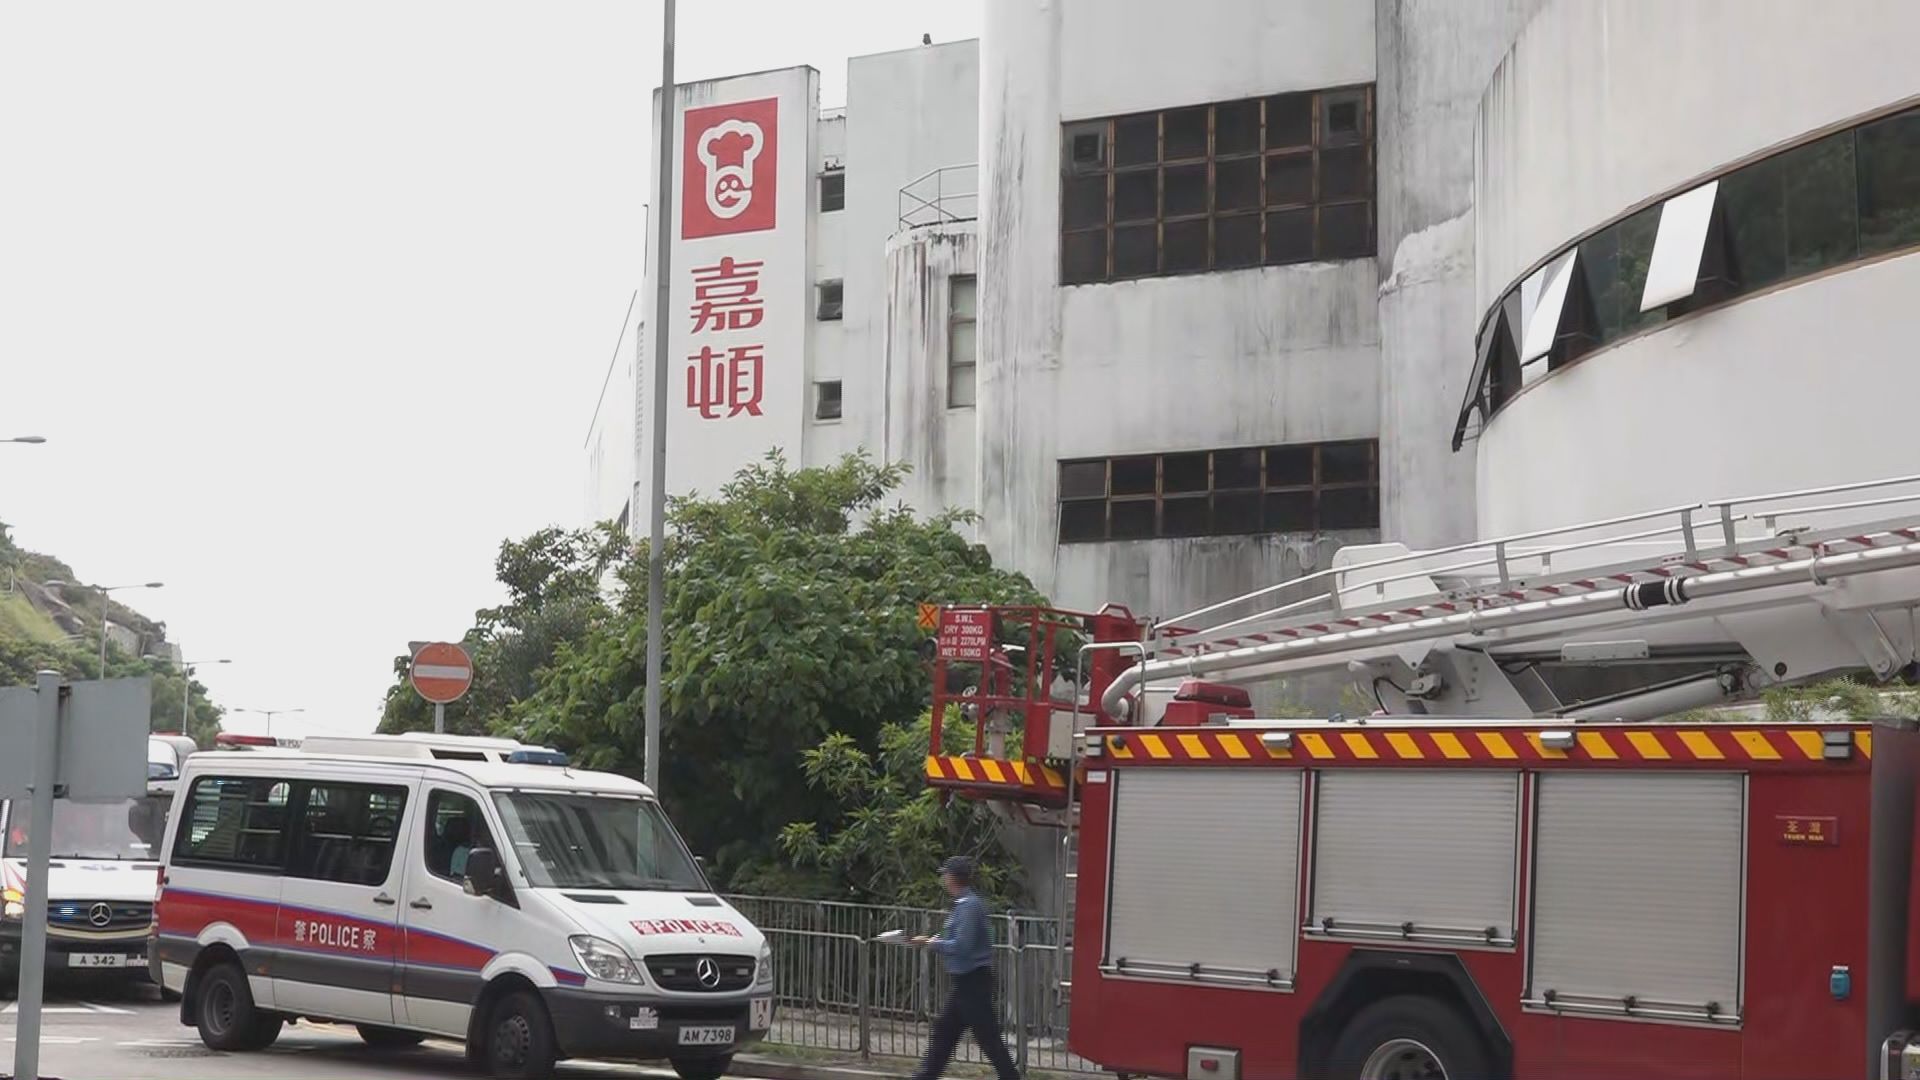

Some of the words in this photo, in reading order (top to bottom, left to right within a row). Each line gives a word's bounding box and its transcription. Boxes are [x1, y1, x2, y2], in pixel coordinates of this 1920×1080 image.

[686, 256, 765, 419] 嘉頓
[942, 647, 957, 657] WET
[309, 921, 360, 949] POLICE
[93, 955, 115, 966] 342
[683, 1031, 700, 1043] AM
[702, 1029, 732, 1043] 7398
